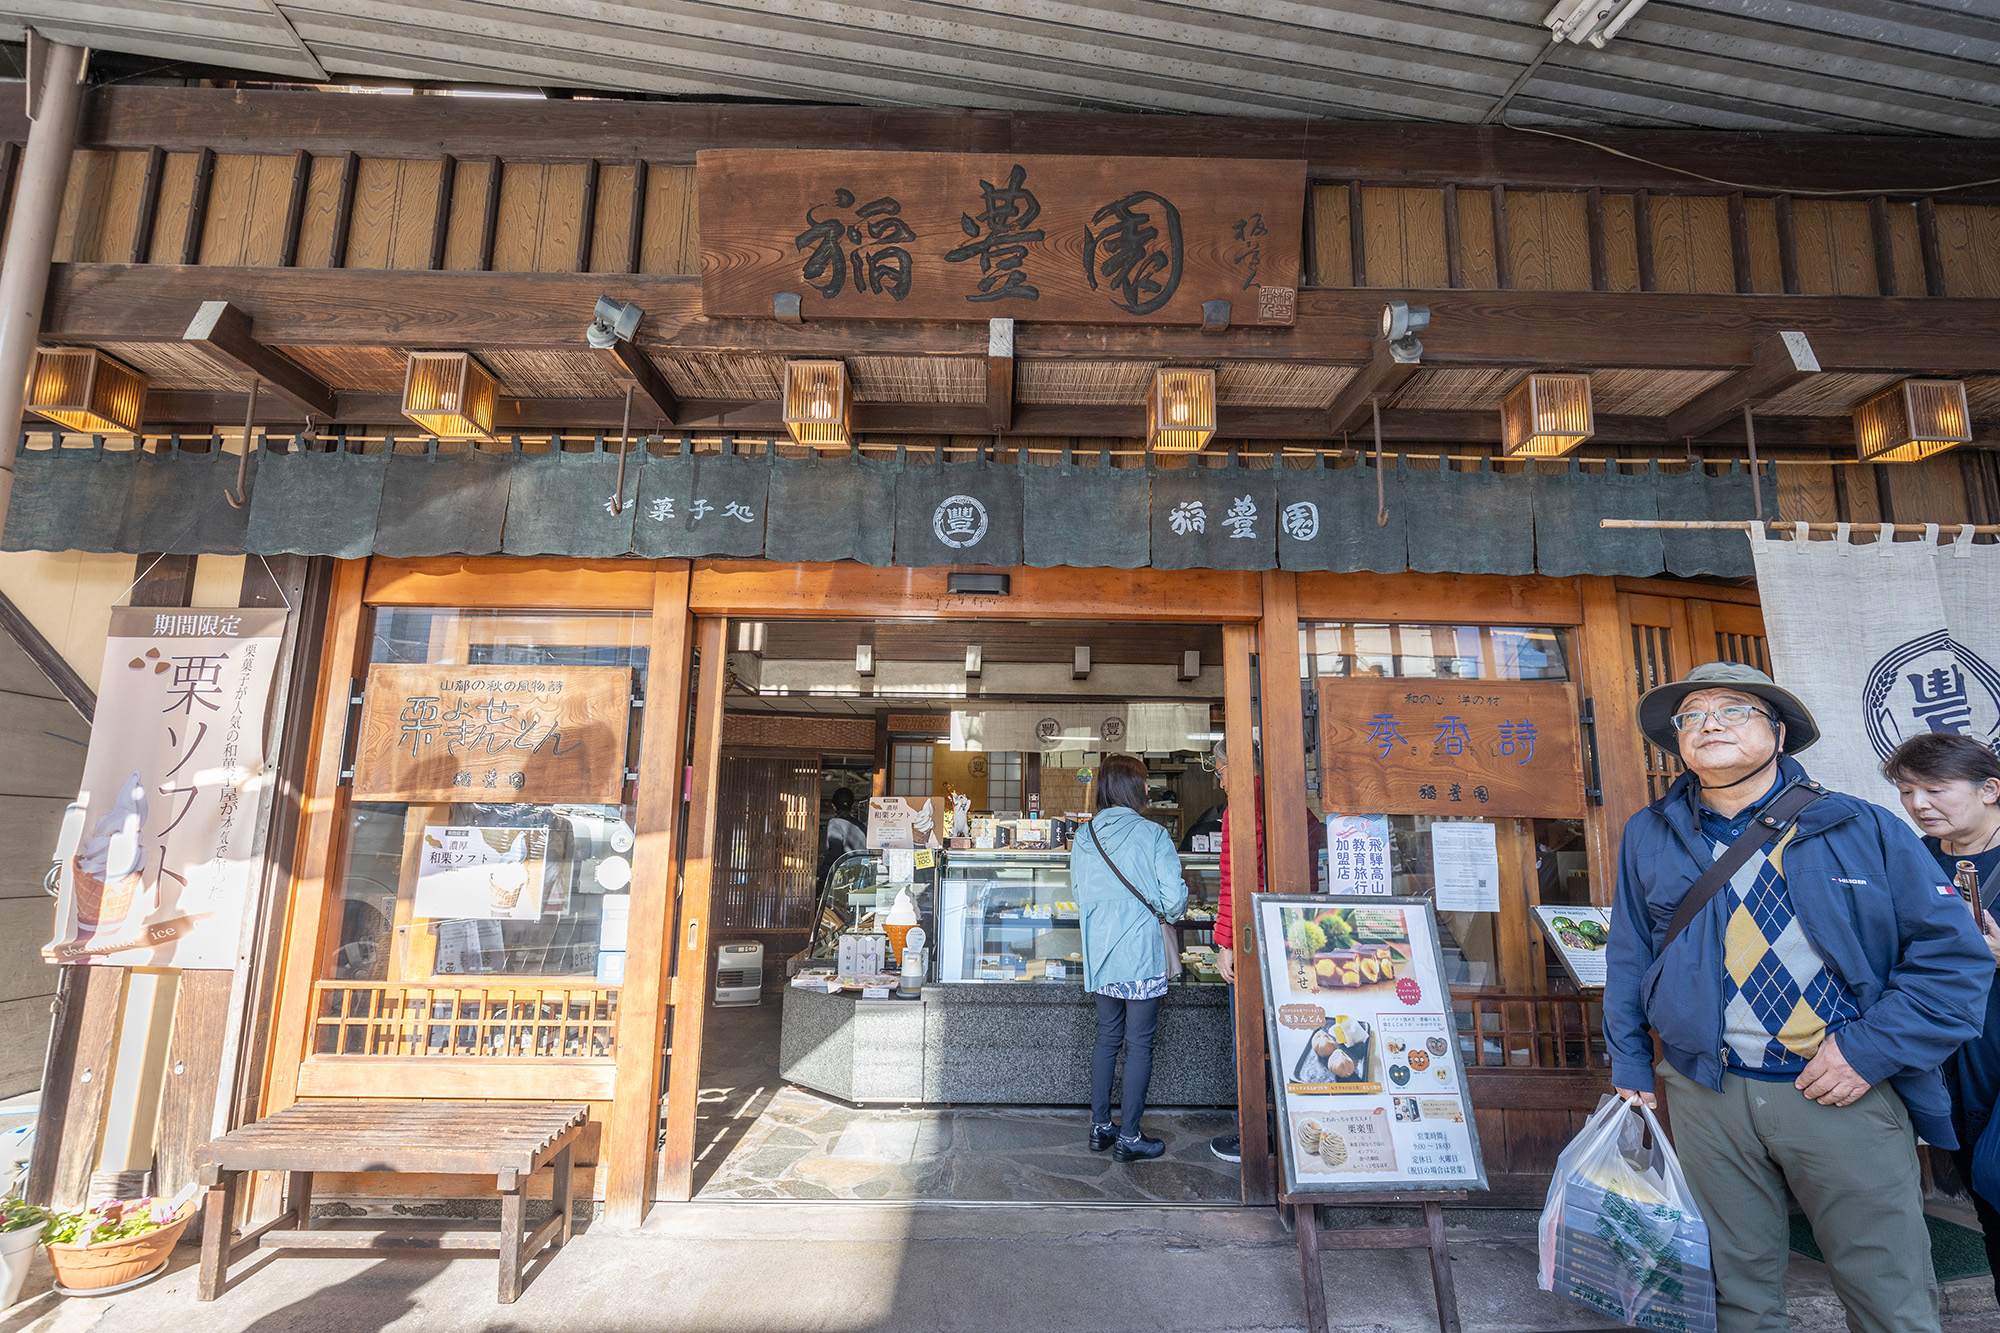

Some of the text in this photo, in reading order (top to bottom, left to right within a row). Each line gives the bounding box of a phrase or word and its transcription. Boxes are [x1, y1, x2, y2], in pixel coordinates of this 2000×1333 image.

[796, 164, 1183, 316] 稲豊園
[1169, 494, 1320, 542] 稲豊園
[153, 614, 242, 637] 期間限定
[1404, 694, 1501, 707] 和の心 洋の材
[1365, 714, 1539, 765] 季香詩
[154, 652, 229, 909] 栗ソフト
[453, 769, 526, 789] 稲豊園
[1419, 782, 1490, 804] 稲豊園
[448, 840, 468, 850] 濃厚
[429, 852, 488, 864] 和栗ソフト
[1336, 838, 1350, 880] 加盟店
[1352, 838, 1368, 894] 教育旅行
[1369, 838, 1384, 894] 飛騨高山
[150, 924, 176, 940] ice
[1284, 1014, 1323, 1023] 栗きんとん
[1348, 1124, 1375, 1134] 栗楽里
[1417, 1132, 1444, 1140] 営業時間
[1412, 1155, 1459, 1164] 定休日 火曜日
